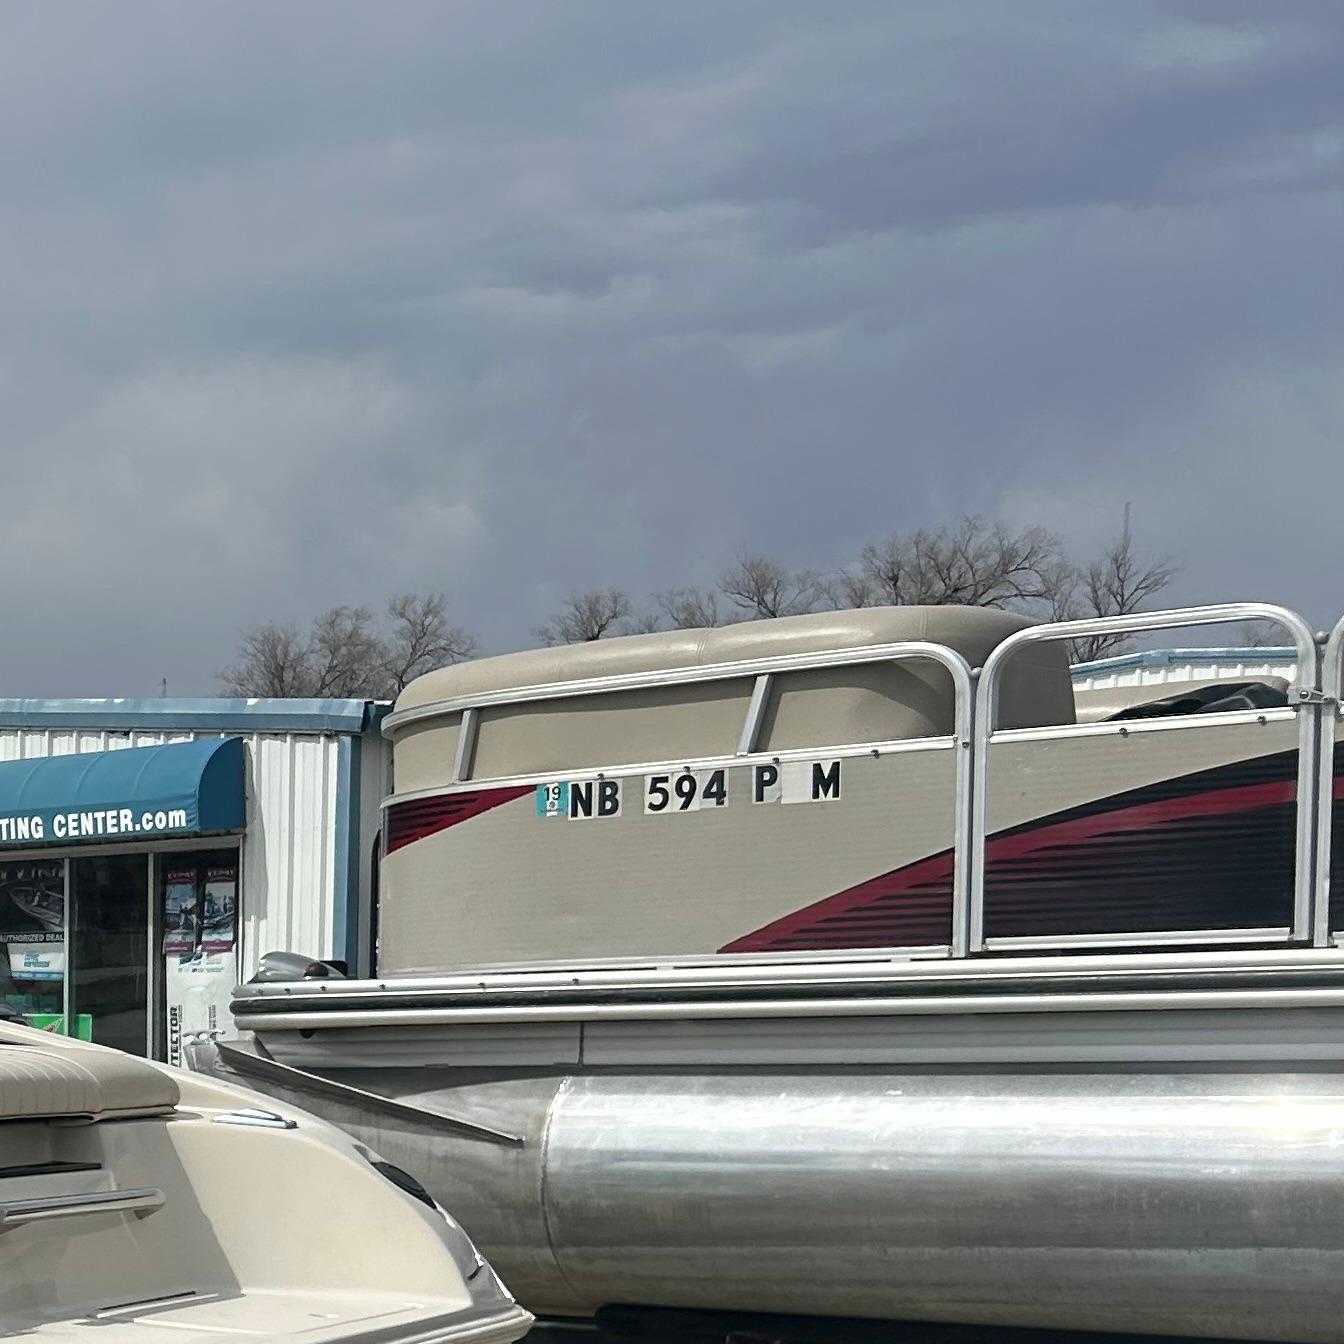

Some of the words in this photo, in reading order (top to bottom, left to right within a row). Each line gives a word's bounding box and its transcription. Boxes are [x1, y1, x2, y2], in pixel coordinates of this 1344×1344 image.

[544, 786, 561, 801] 19
[570, 780, 619, 818] NB
[648, 770, 727, 811] 594
[755, 765, 778, 802] P
[812, 761, 840, 800] M
[53, 808, 187, 838] CENTER.com
[45, 932, 65, 942] DEAL
